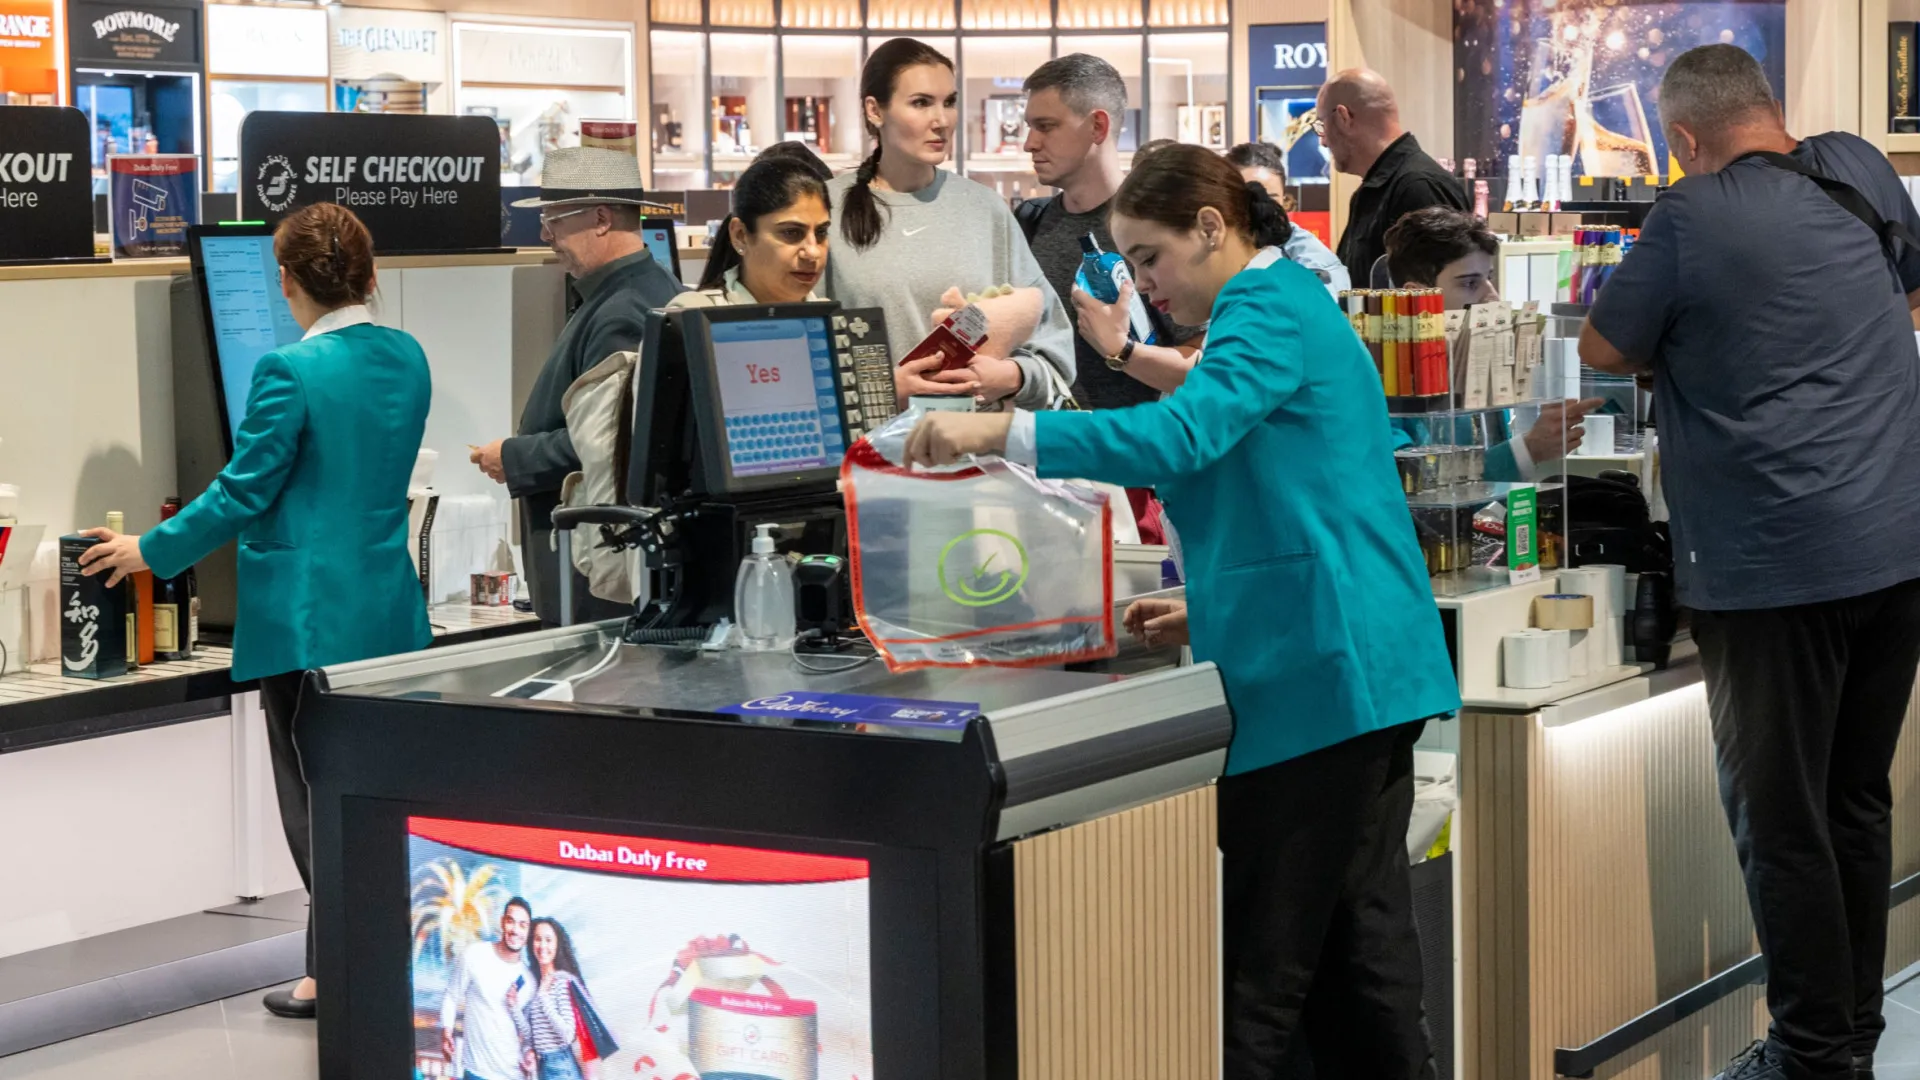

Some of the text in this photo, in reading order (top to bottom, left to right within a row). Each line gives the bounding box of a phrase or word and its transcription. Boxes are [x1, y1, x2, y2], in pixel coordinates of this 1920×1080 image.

[92, 11, 178, 43] BOWMORE
[1273, 42, 1328, 69] ROY
[304, 155, 485, 184] SELF CHECKOUT
[336, 186, 458, 208] Please Pay Here
[745, 363, 781, 384] Yes
[740, 695, 859, 719] Cadbury
[559, 840, 708, 871] Dubai Duty Free
